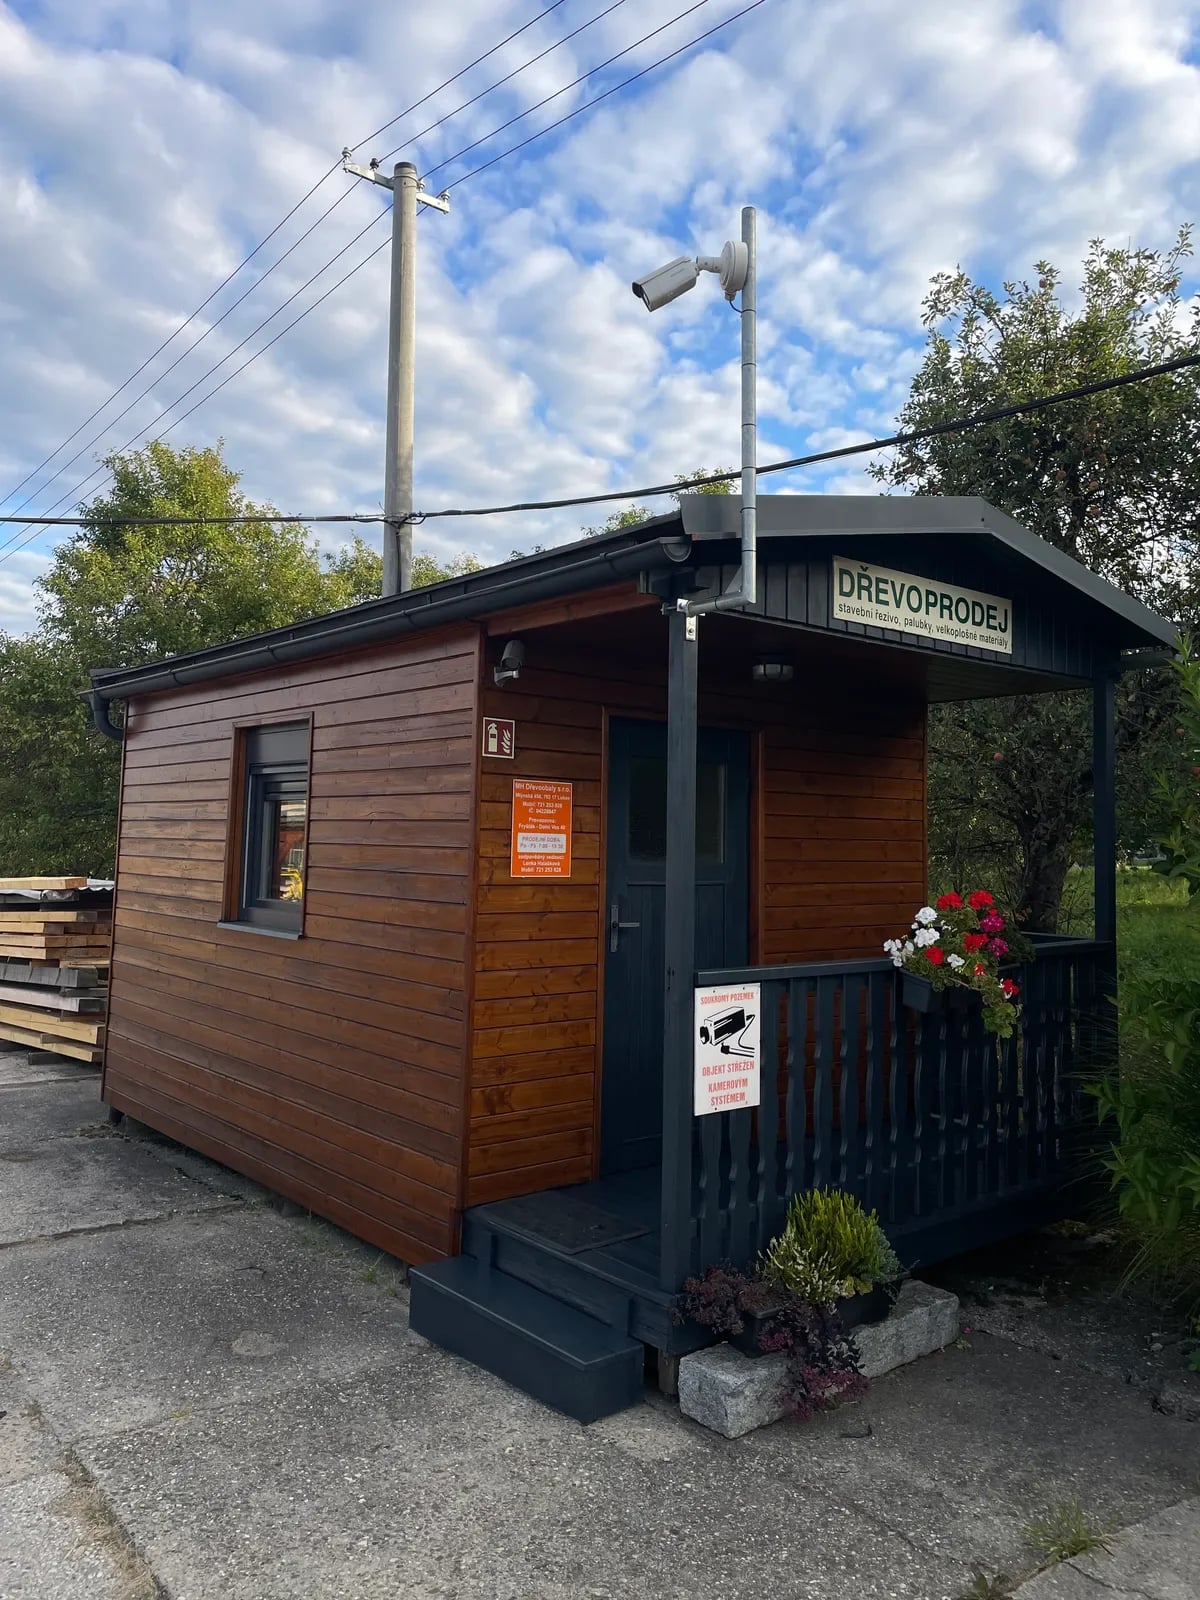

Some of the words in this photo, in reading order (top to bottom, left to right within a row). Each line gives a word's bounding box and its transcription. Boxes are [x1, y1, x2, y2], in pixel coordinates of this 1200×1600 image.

[839, 565, 1008, 633] DŘEVOPRODEJ
[838, 602, 873, 619] stavební
[875, 609, 901, 626] řezivo,
[904, 617, 934, 636] palubky,
[936, 624, 977, 641] velkoplošné
[979, 634, 1009, 650] materiály
[730, 992, 754, 1002] POZEMEK
[702, 1064, 726, 1077] OBJEKT
[727, 1060, 755, 1074] STŘEŽEN
[708, 1076, 748, 1093] KAMEROVÝM
[710, 1091, 746, 1107] SYSTÉMEM
